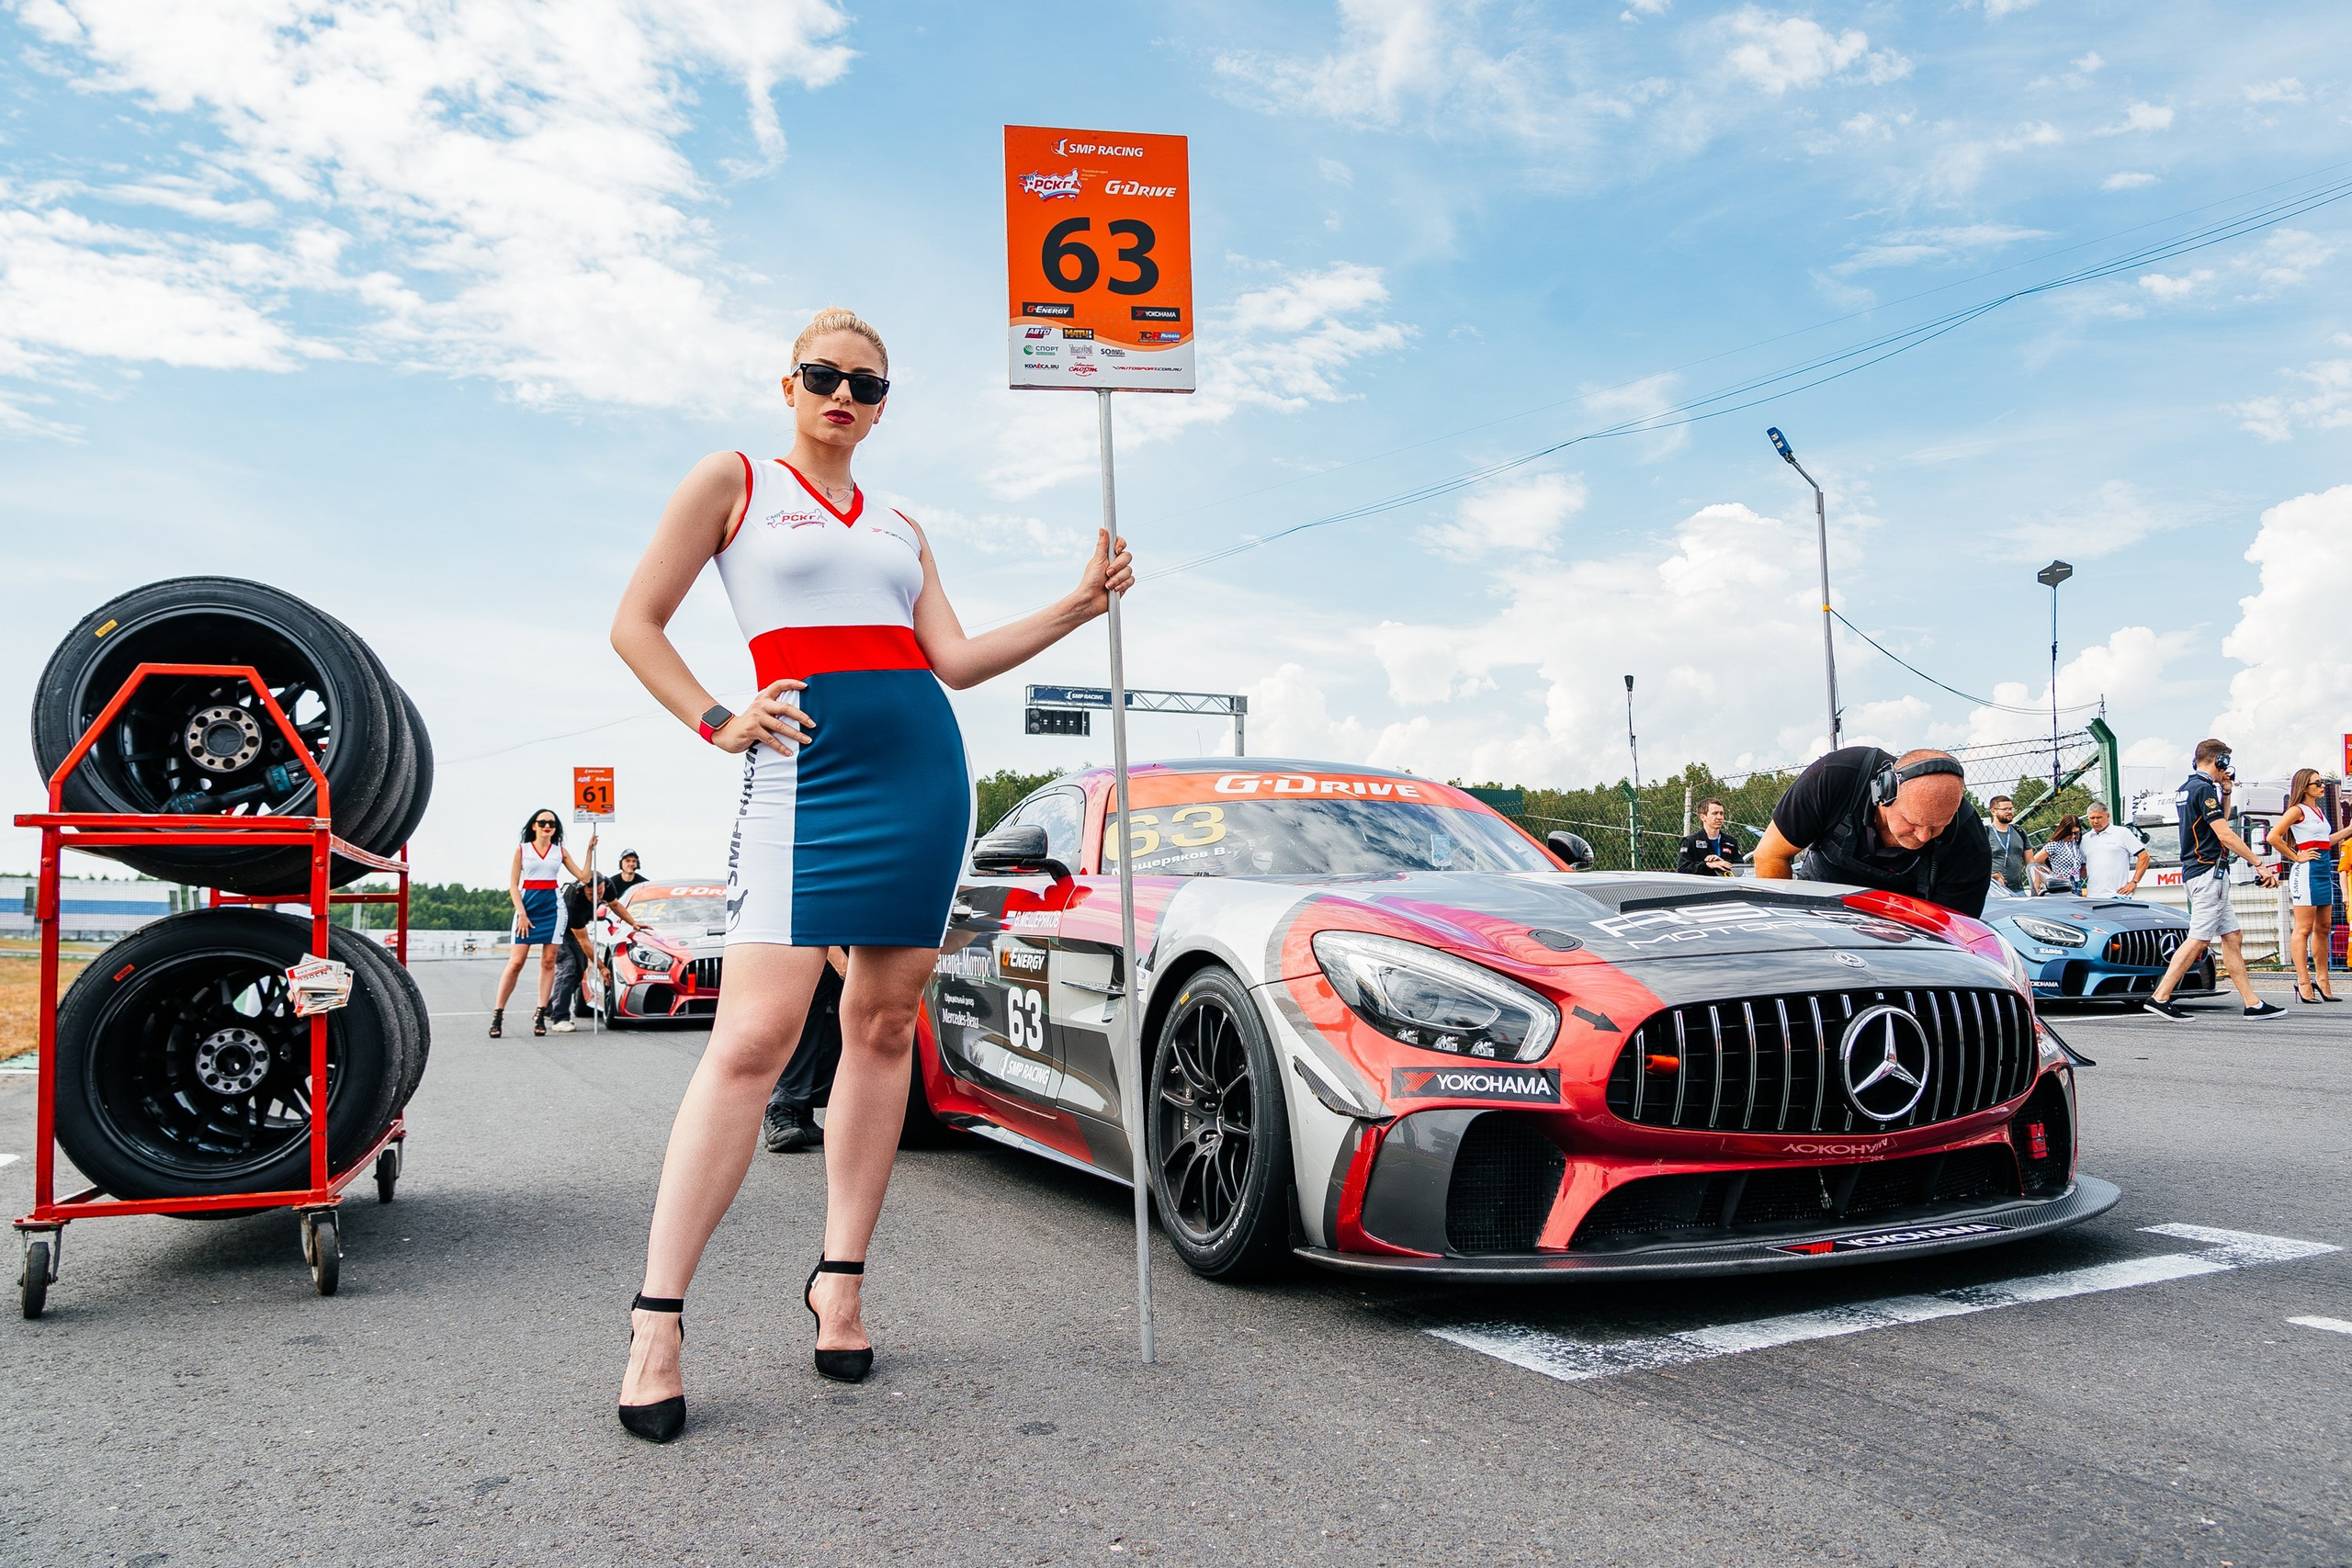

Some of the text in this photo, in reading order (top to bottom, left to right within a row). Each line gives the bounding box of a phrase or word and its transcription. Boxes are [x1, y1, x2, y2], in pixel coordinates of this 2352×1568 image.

[1068, 143, 1144, 157] SMP RACING
[1034, 179, 1071, 190] РСКГ
[1041, 217, 1159, 296] 63
[781, 514, 816, 523] РСКГ
[582, 785, 606, 803] 61
[1104, 806, 1227, 862] 63
[2157, 873, 2182, 886] МАТ
[942, 1008, 979, 1029] Mercedes-Benz
[1007, 987, 1044, 1053] 63
[1007, 1059, 1050, 1085] SMP RACING
[1435, 1074, 1551, 1096] YOKOHAMA
[1836, 1224, 2002, 1247] YOKOHAMA
